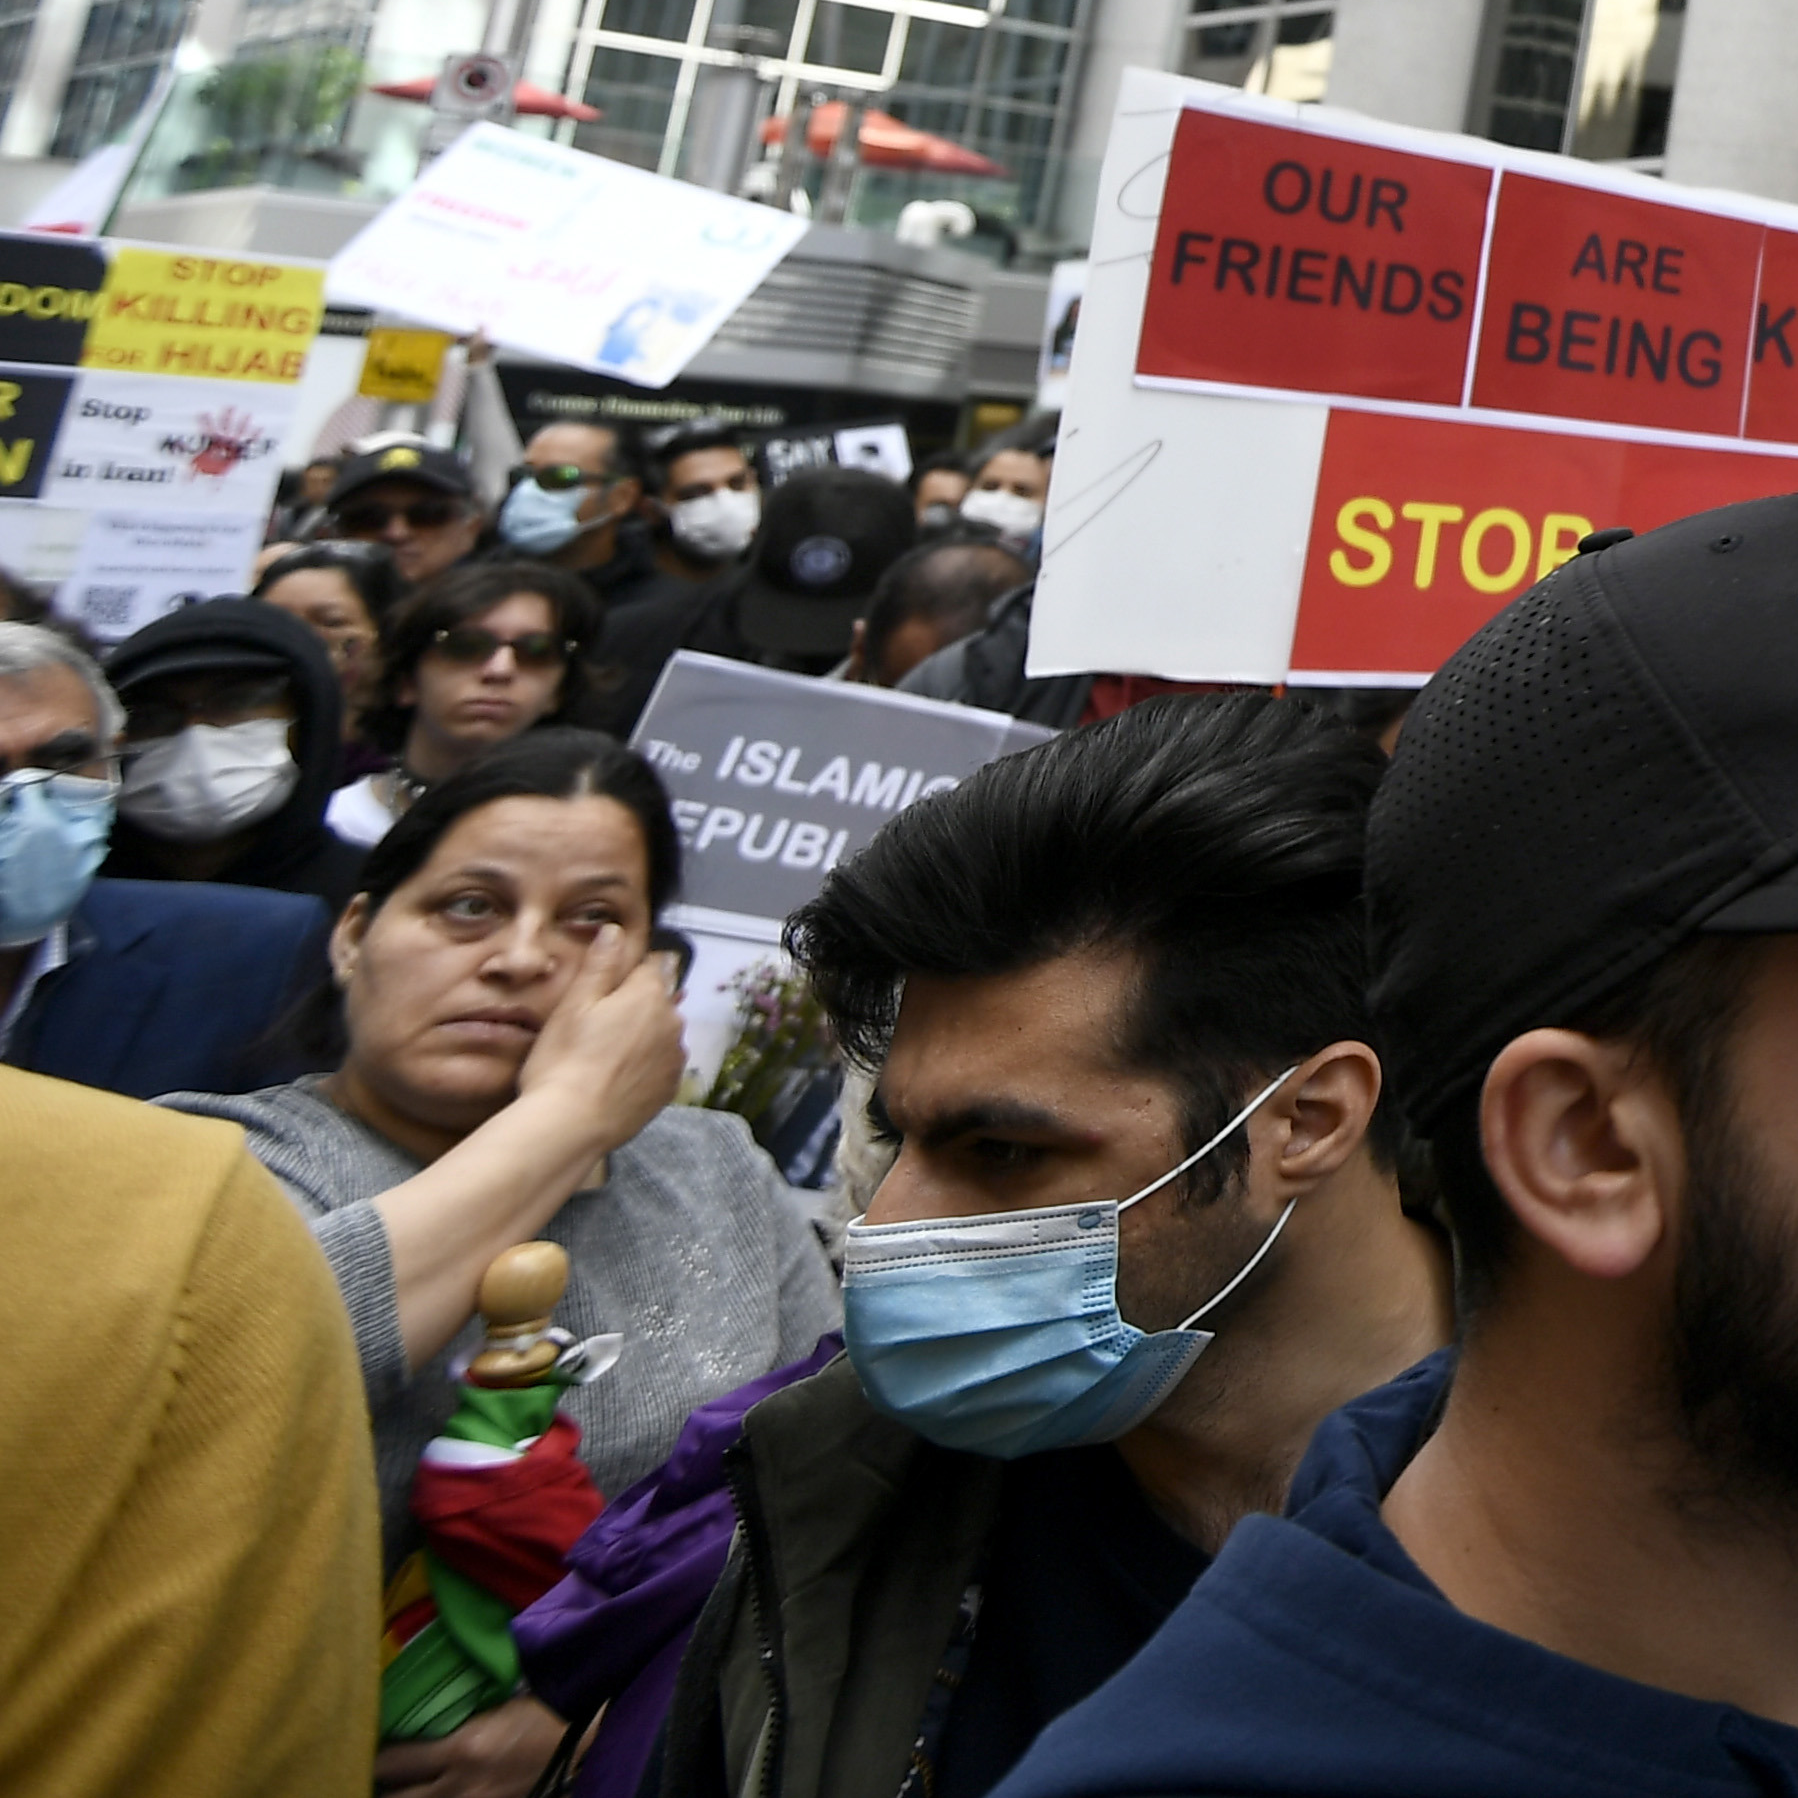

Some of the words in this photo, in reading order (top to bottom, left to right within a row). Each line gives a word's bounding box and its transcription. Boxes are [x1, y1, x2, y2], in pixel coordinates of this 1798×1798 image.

[1262, 160, 1410, 233] OUR
[172, 255, 282, 288] STOP
[1169, 231, 1468, 324] FRIENDS
[1570, 233, 1687, 296] ARE
[107, 290, 312, 335] KILLING
[86, 347, 144, 367] FOR
[159, 340, 305, 380] HIJAB
[1504, 301, 1724, 389] BEING
[80, 398, 151, 425] Stop
[62, 459, 92, 479] in
[1329, 495, 1593, 595] STOP
[646, 738, 702, 774] The
[671, 798, 850, 874] EPUBL
